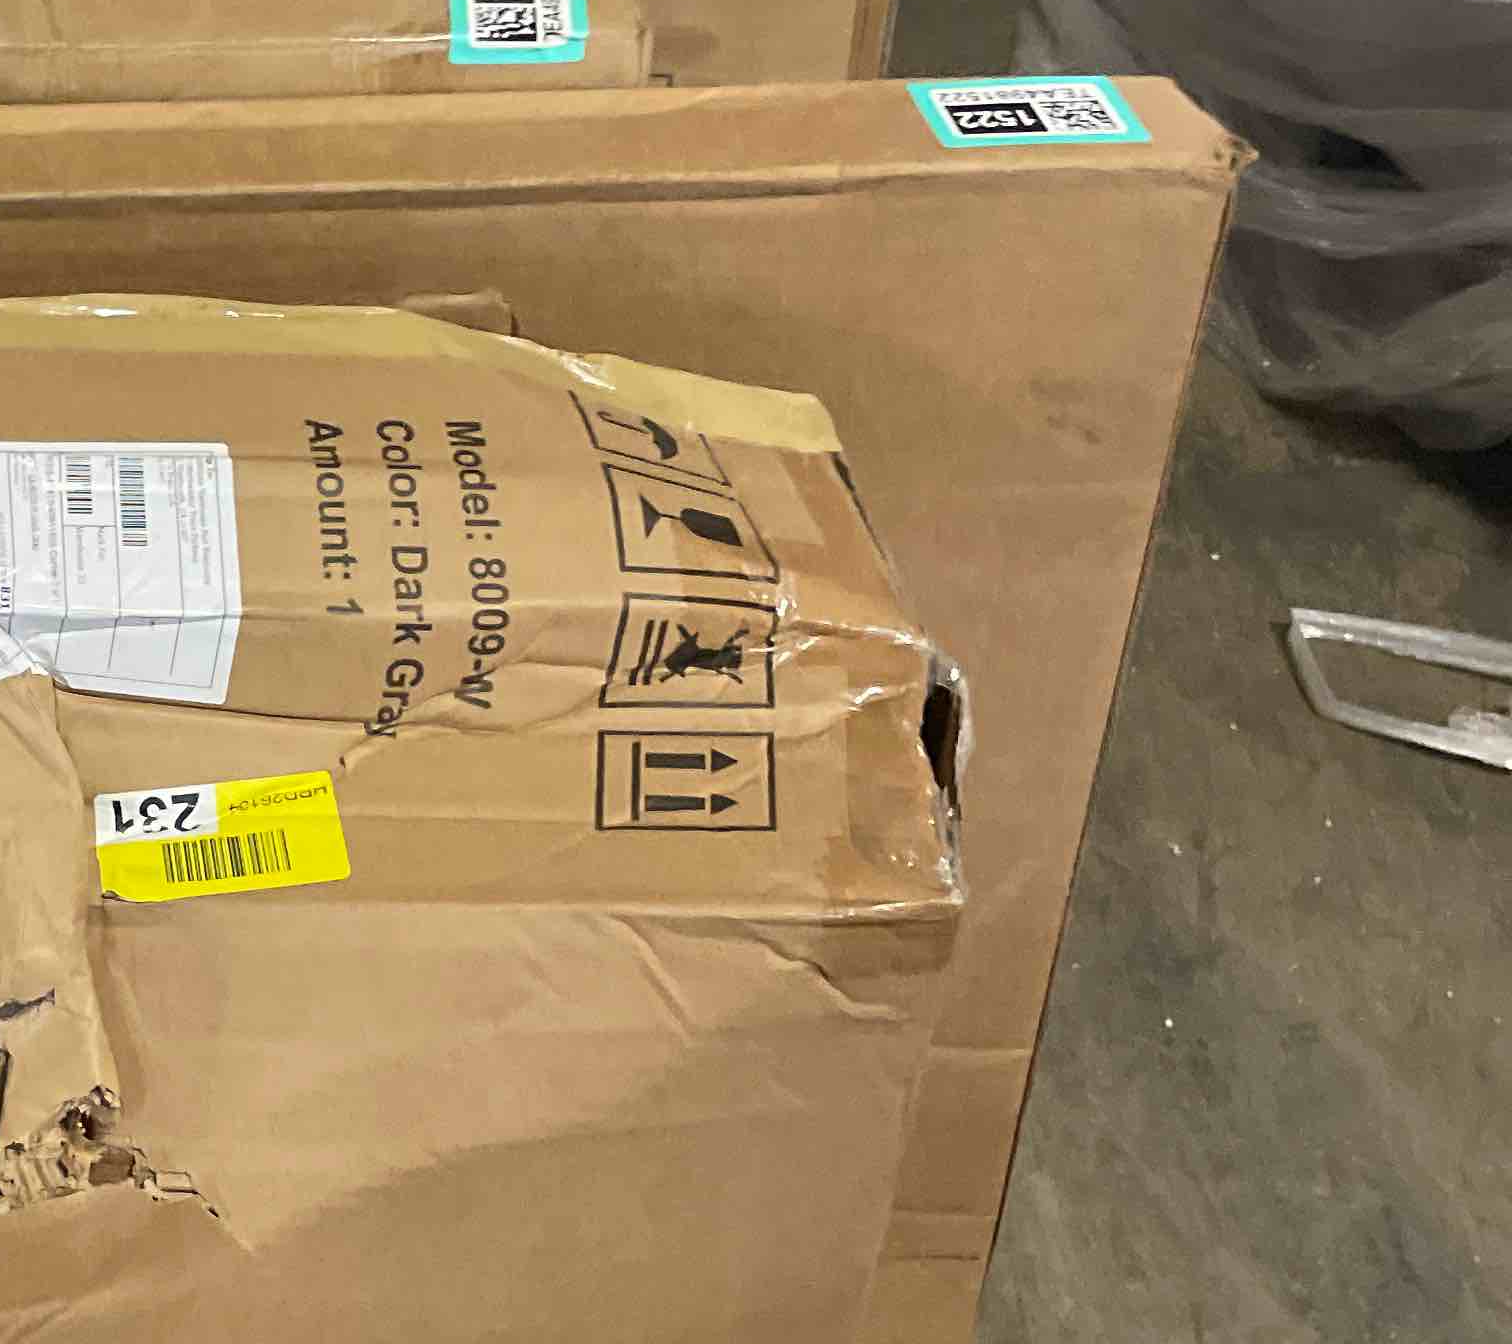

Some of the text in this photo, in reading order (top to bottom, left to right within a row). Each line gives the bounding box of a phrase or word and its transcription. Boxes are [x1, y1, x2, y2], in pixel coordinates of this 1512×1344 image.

[951, 108, 1038, 130] 1522
[303, 416, 364, 617] Amount: 1
[362, 417, 434, 740] Color: Dark Gray
[444, 417, 511, 712] Model: 8009-W
[110, 792, 203, 836] 231
